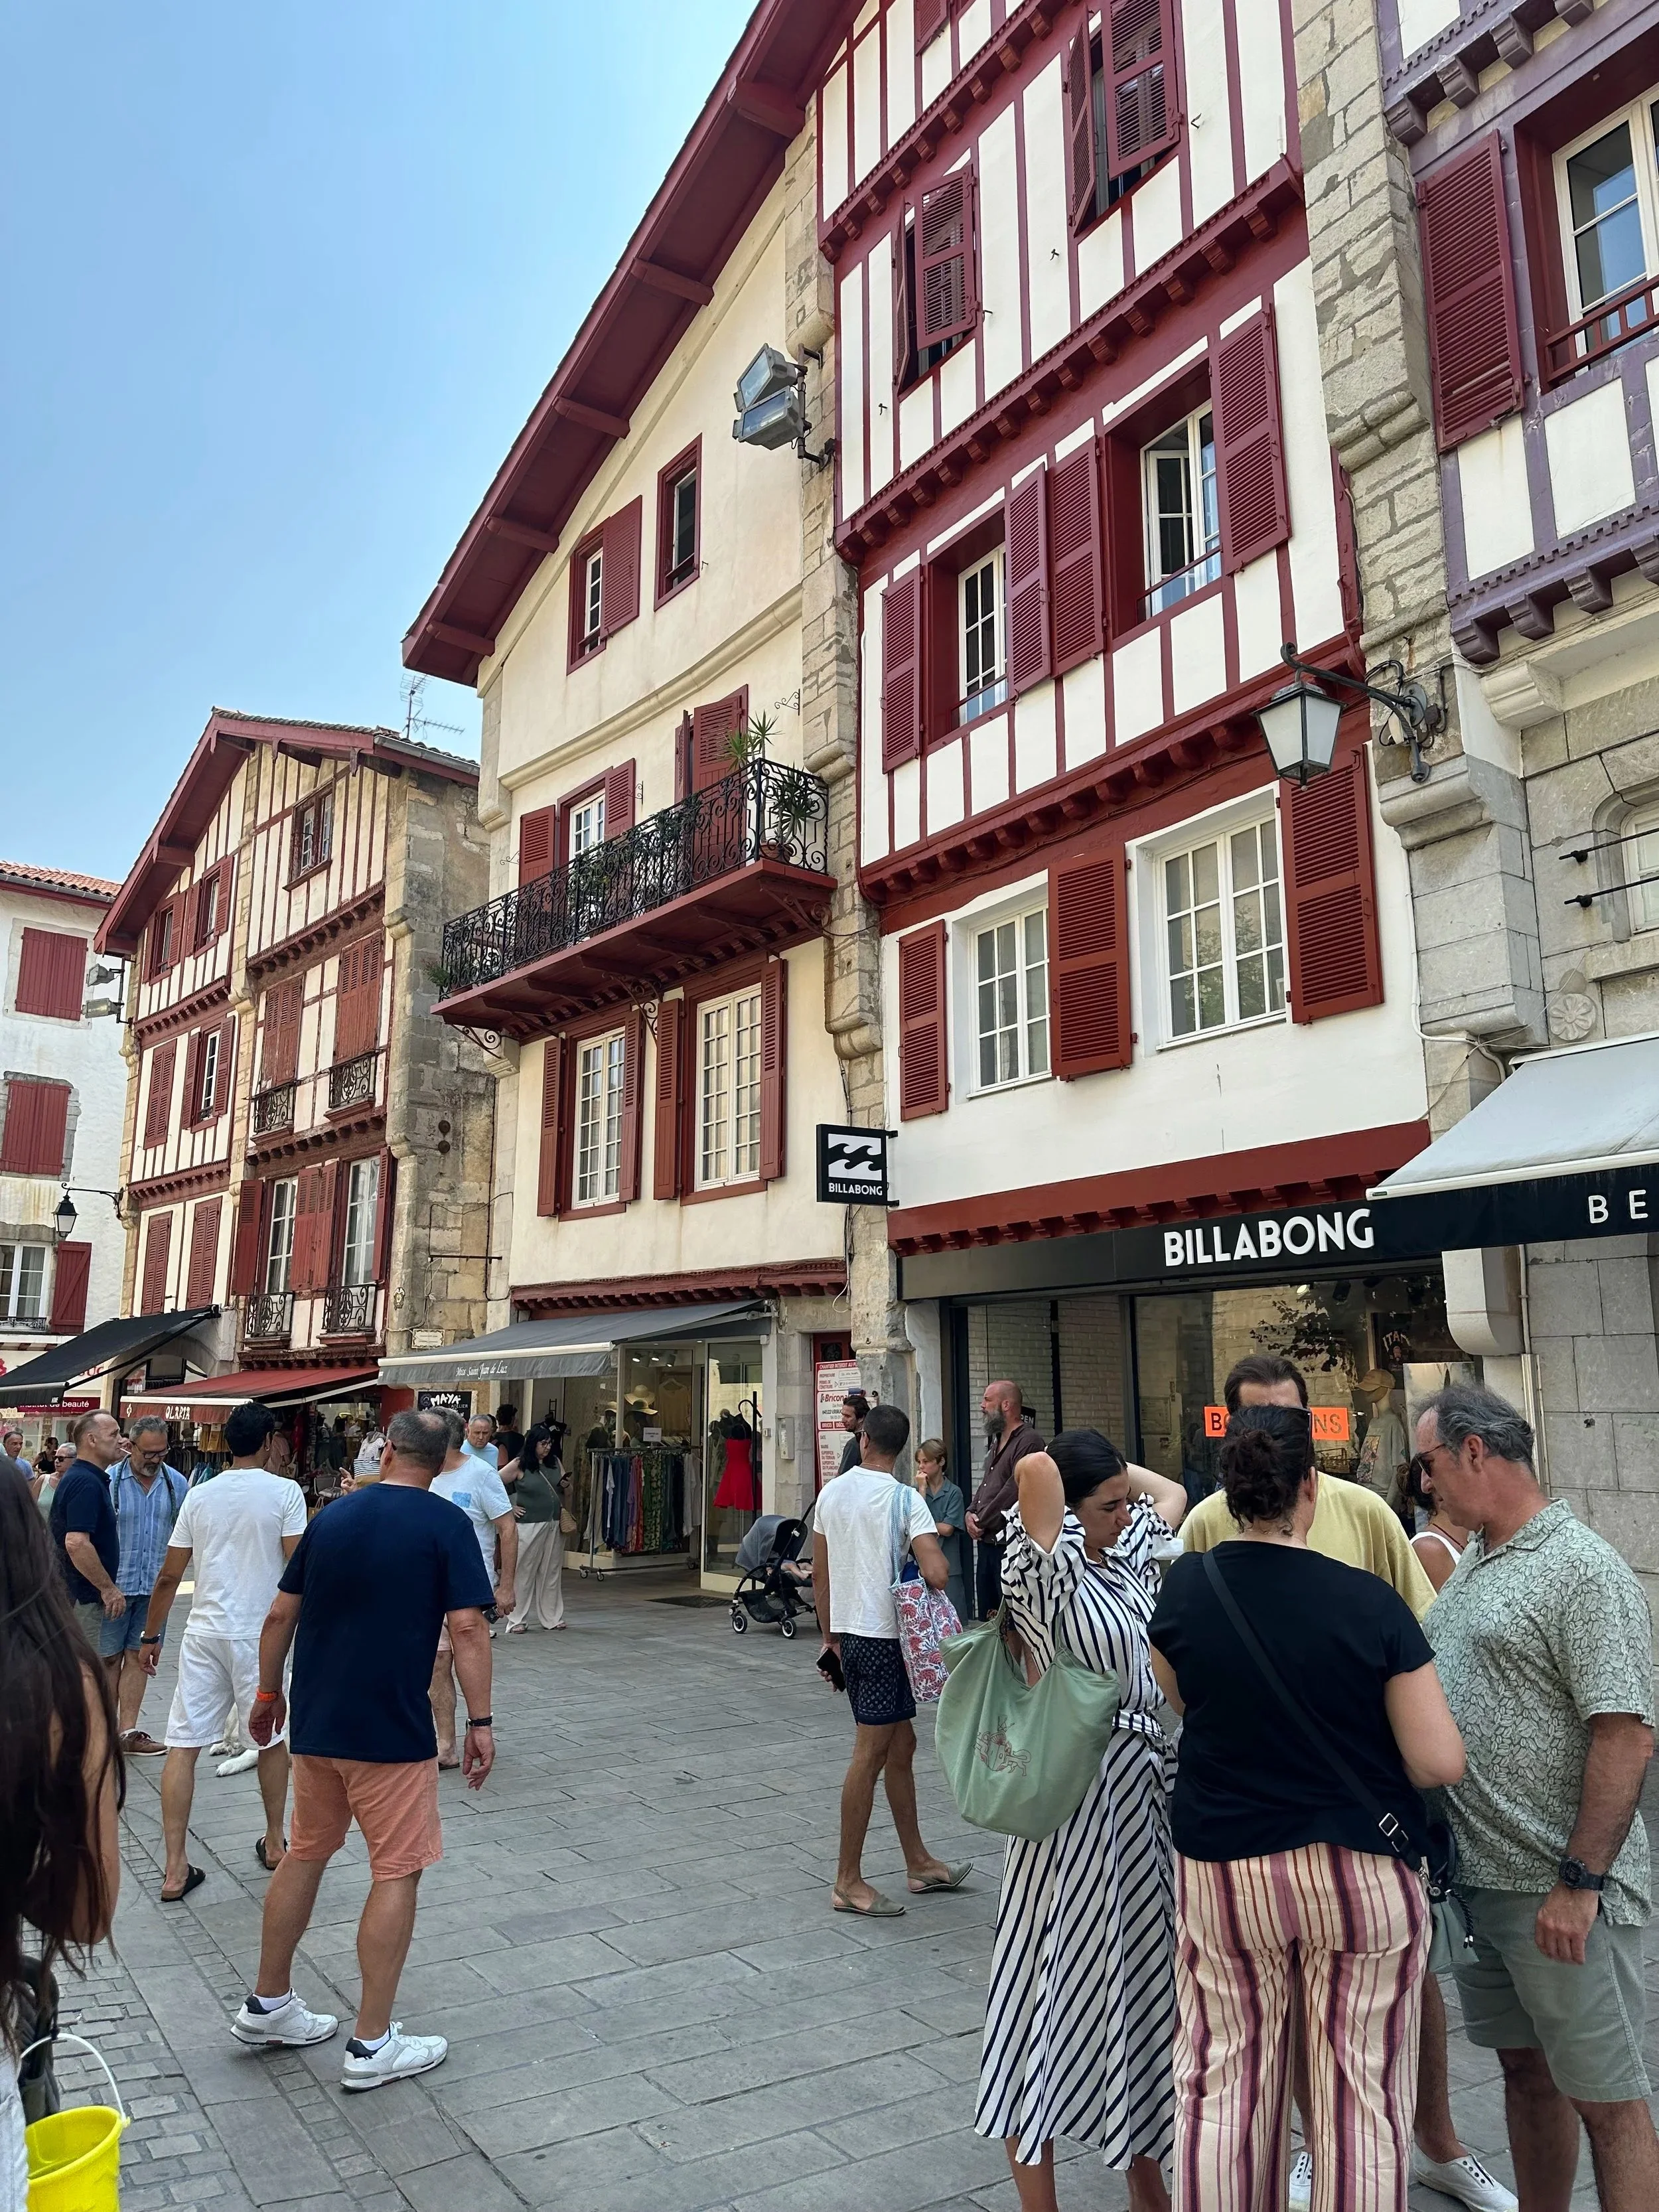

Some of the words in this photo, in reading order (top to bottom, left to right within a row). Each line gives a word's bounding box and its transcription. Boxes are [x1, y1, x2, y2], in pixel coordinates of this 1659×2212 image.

[828, 1183, 883, 1196] BILLABONG
[1163, 1208, 1375, 1267] BILLABONG
[496, 1361, 508, 1374] Luz
[430, 1393, 461, 1407] MAYA
[1020, 1414, 1034, 1425] PEN
